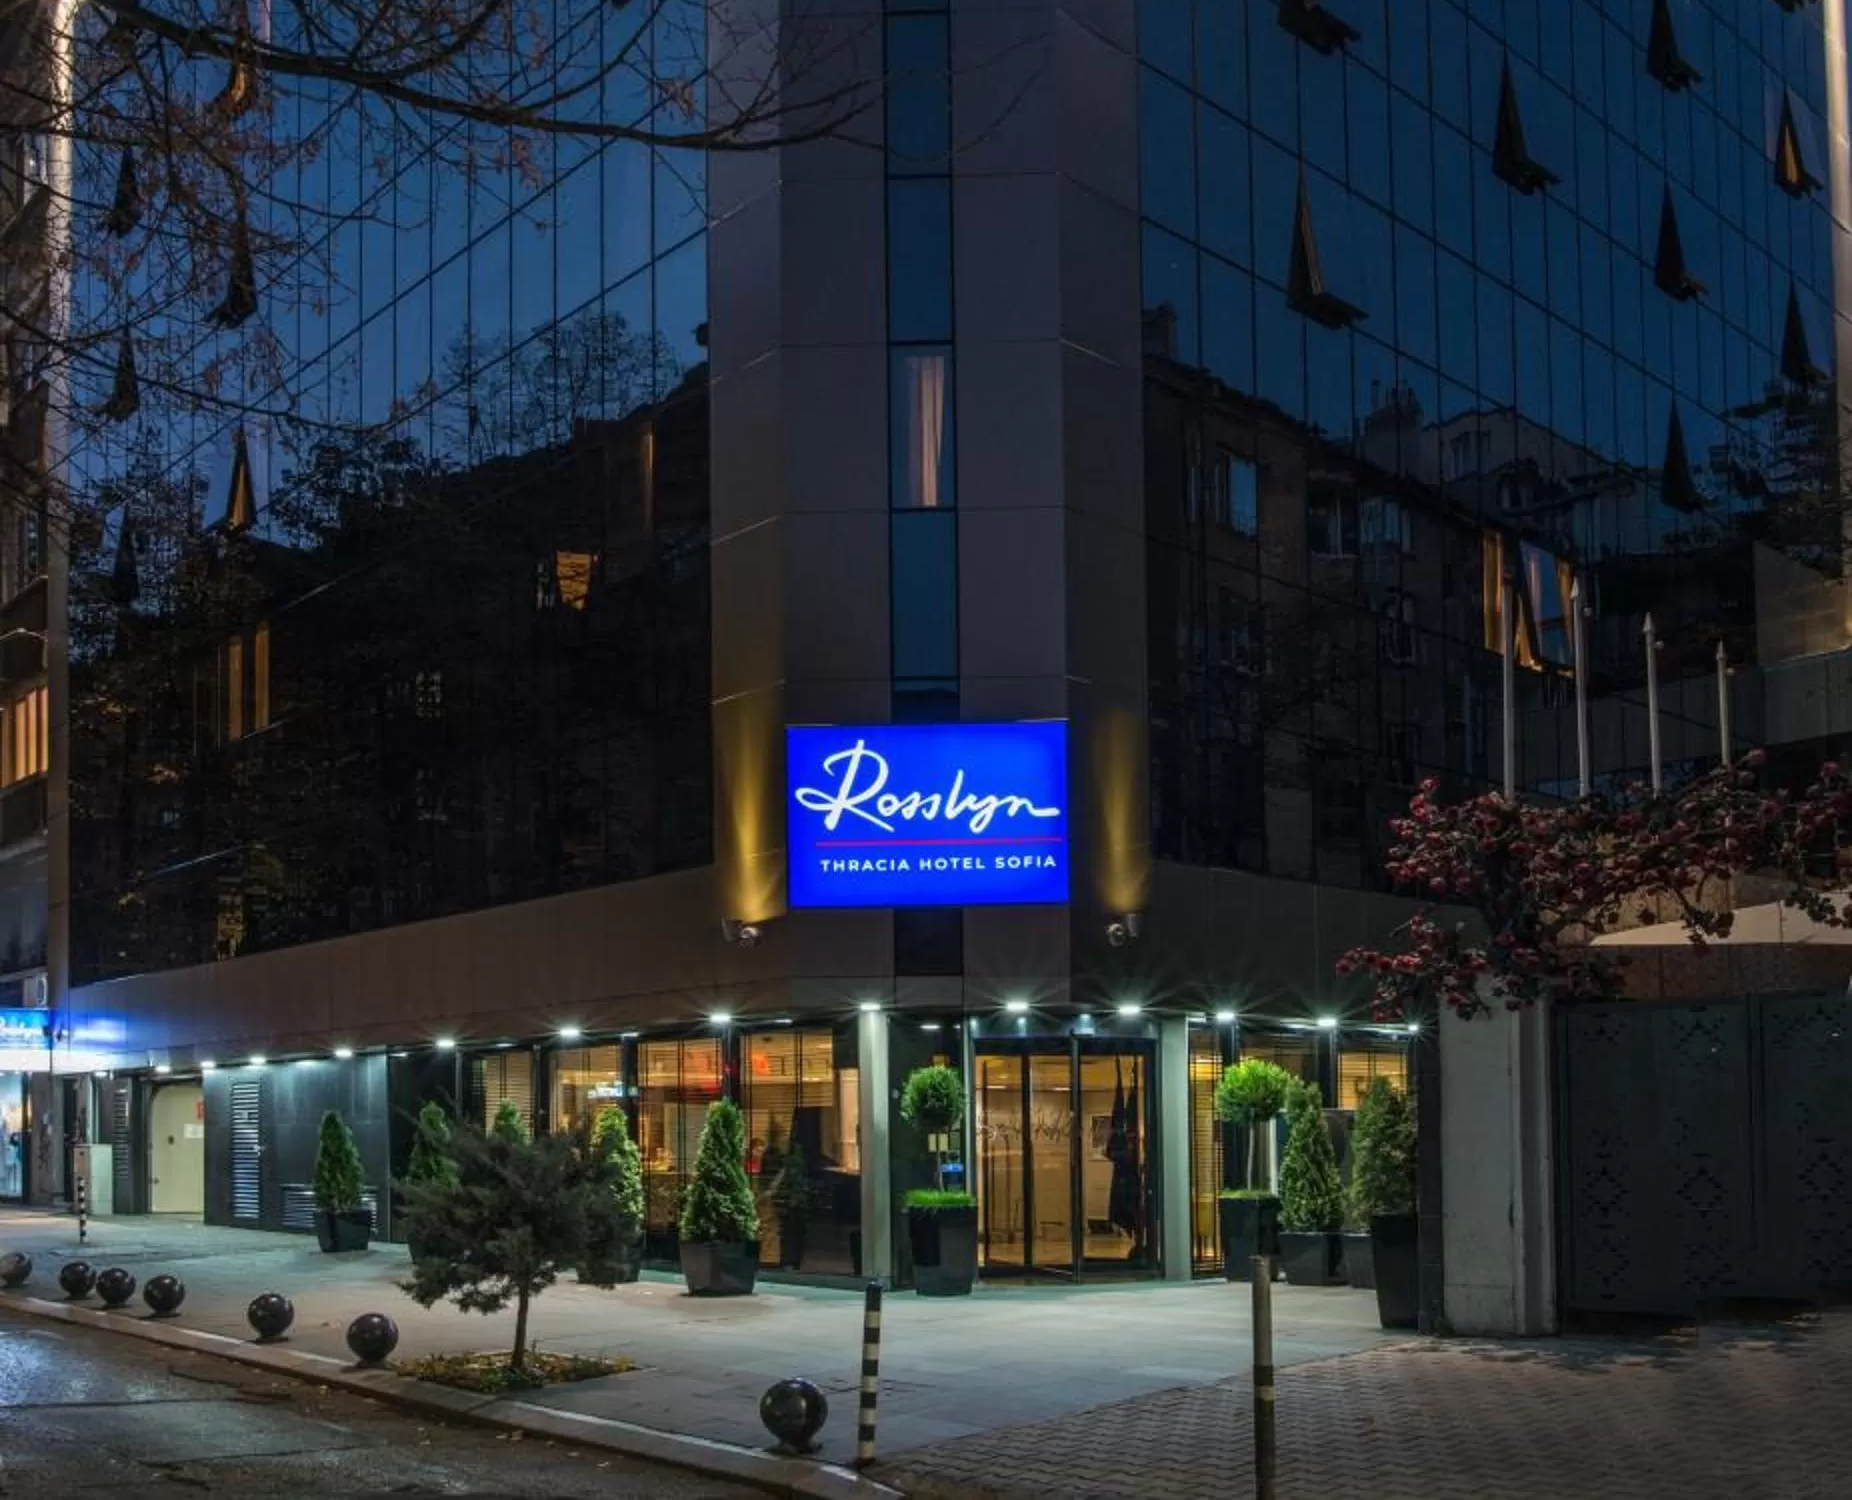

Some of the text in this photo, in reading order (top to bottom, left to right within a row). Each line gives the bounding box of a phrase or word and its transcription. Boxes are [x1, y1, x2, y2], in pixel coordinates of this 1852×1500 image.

[794, 738, 1061, 834] Rosslyn
[819, 854, 1058, 874] THRACIA HOTEL SOFIA
